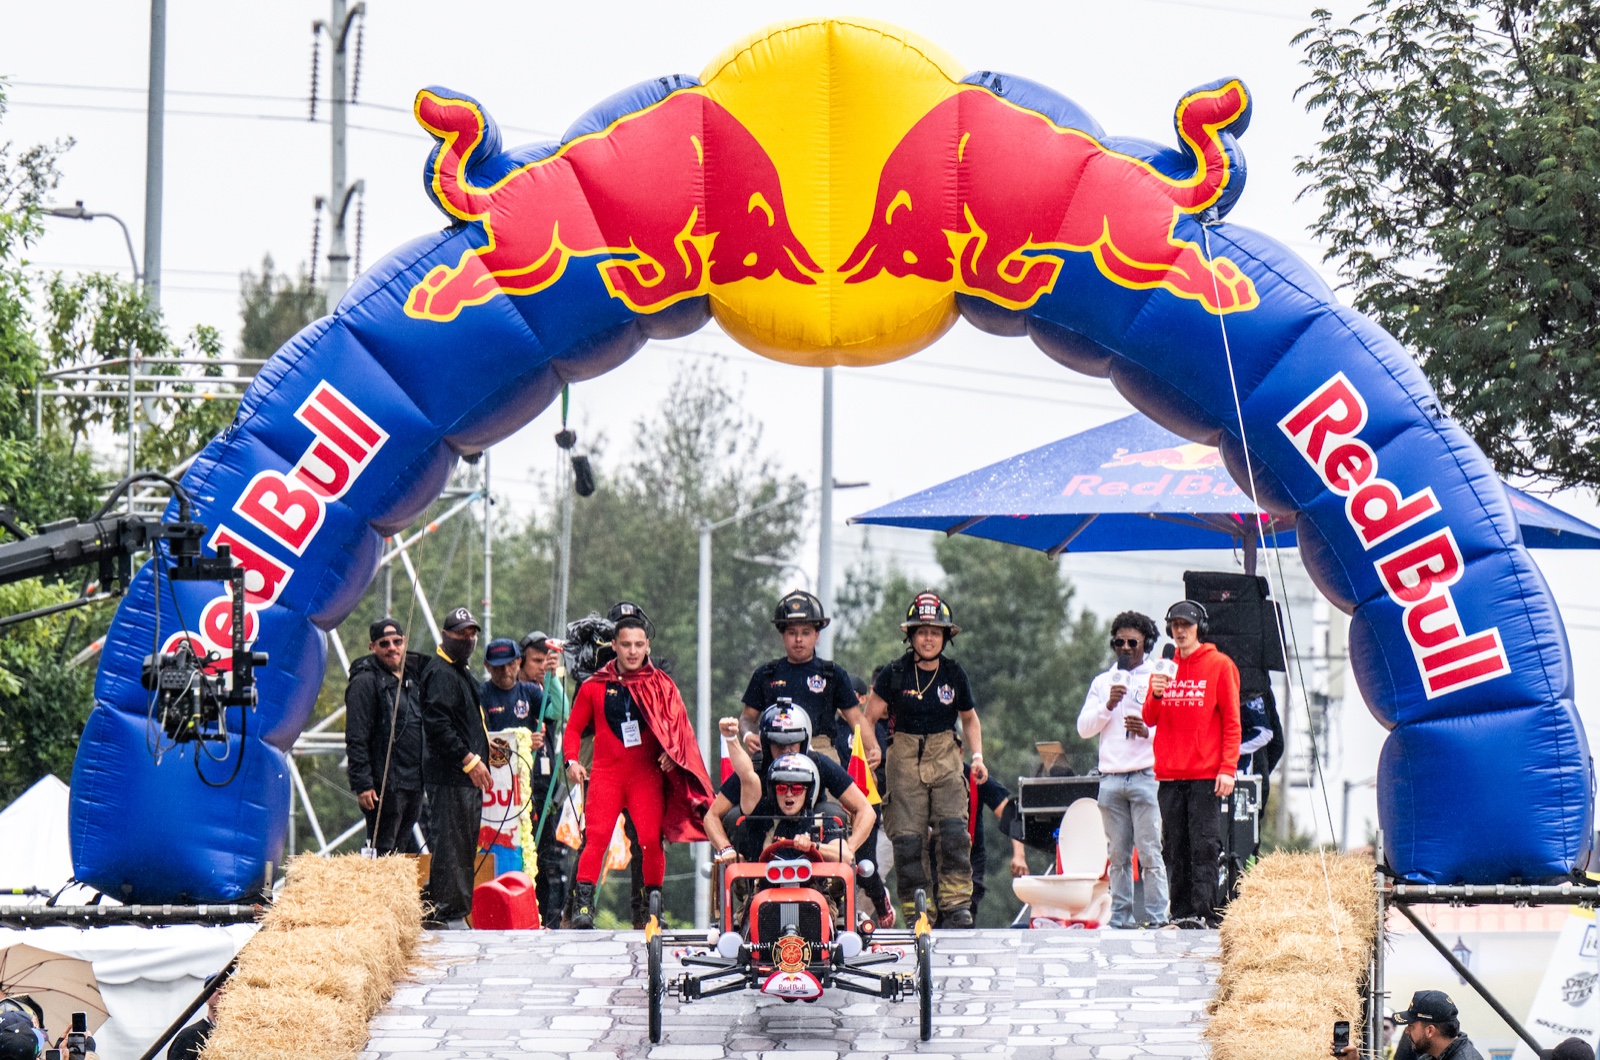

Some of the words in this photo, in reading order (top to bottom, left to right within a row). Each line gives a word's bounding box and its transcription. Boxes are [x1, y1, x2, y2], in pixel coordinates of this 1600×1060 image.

[235, 383, 386, 554] Bull
[1062, 474, 1173, 496] Red
[1173, 474, 1241, 496] Bu
[1281, 375, 1438, 547] Red
[1377, 530, 1507, 696] Bull
[919, 605, 936, 615] 226
[1535, 1018, 1594, 1036] SKECHERS
